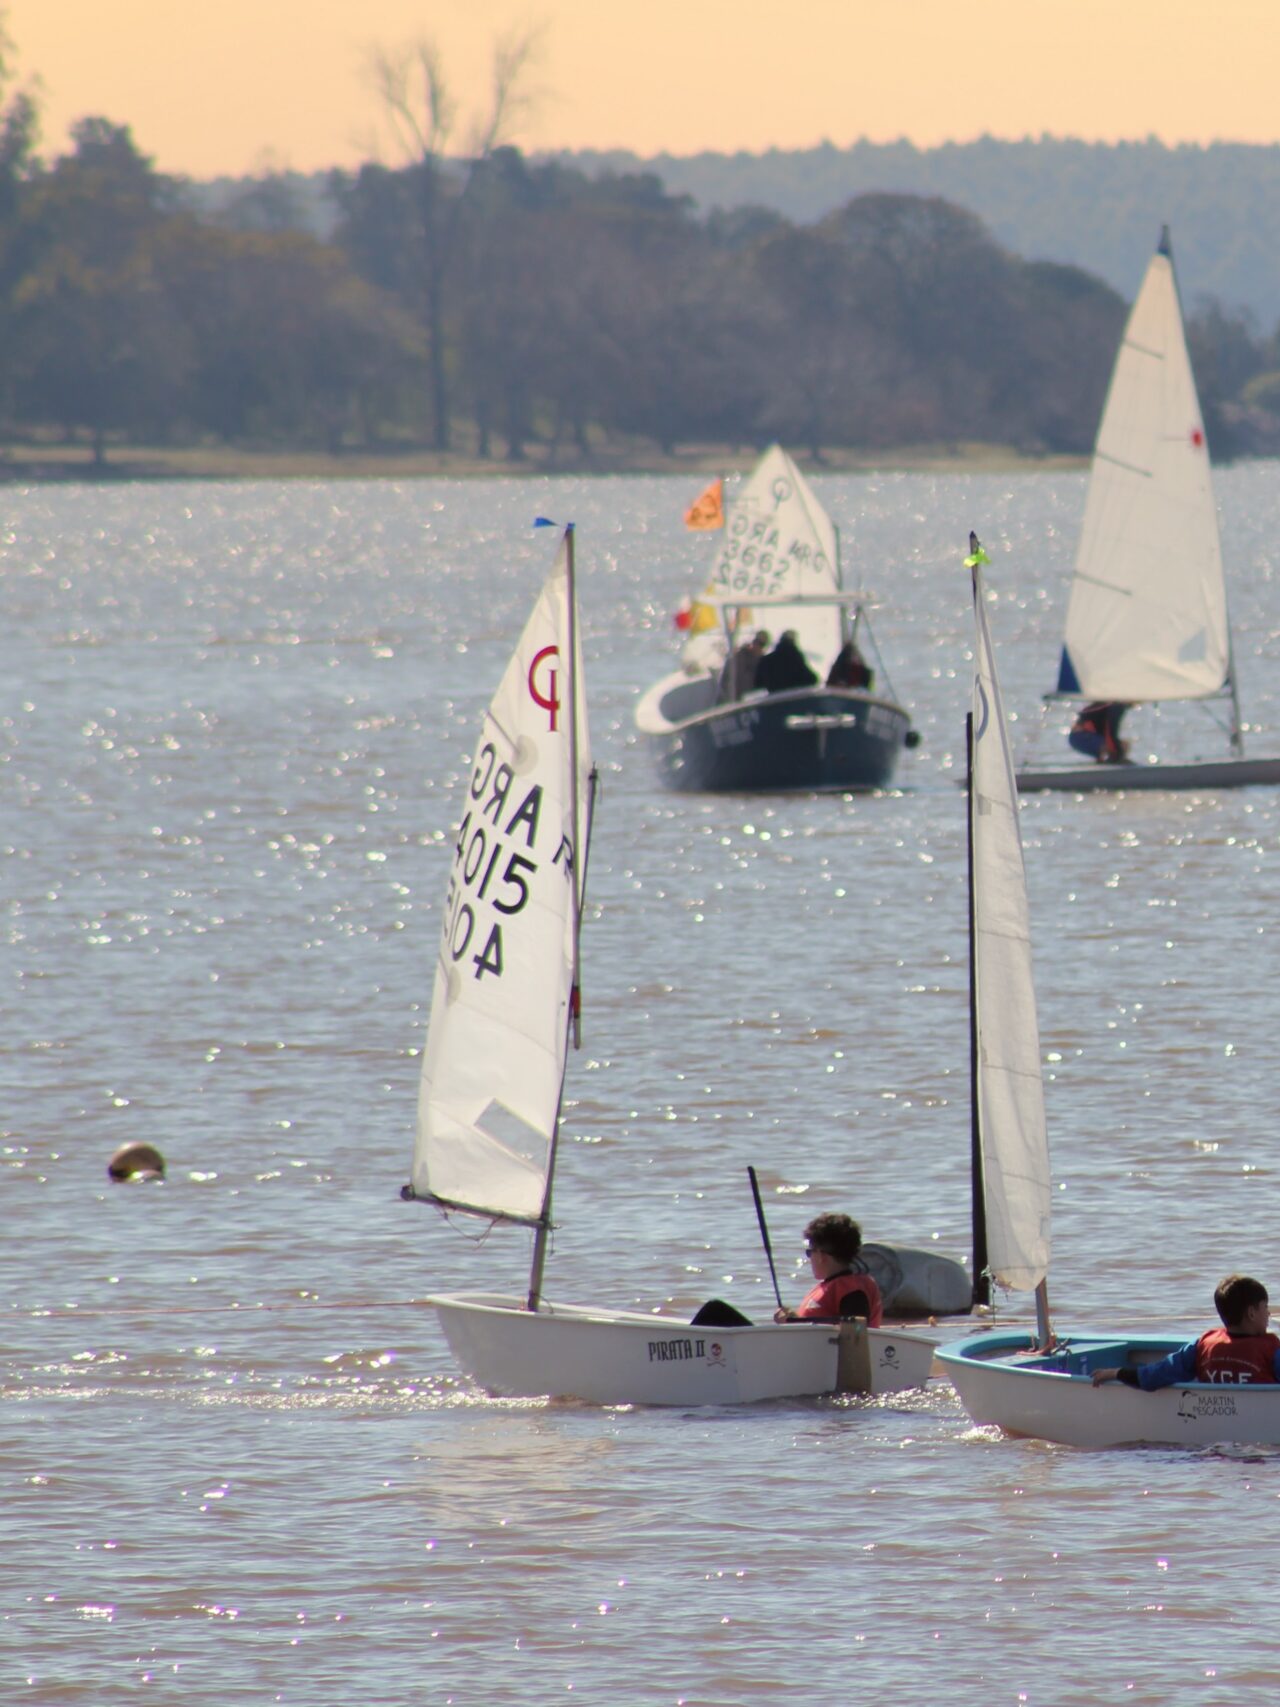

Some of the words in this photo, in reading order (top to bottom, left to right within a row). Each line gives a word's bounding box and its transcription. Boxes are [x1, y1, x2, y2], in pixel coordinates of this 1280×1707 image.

[724, 539, 789, 579] 3662
[648, 1339, 693, 1362] PIRATA
[1198, 1396, 1235, 1406] MARTIN
